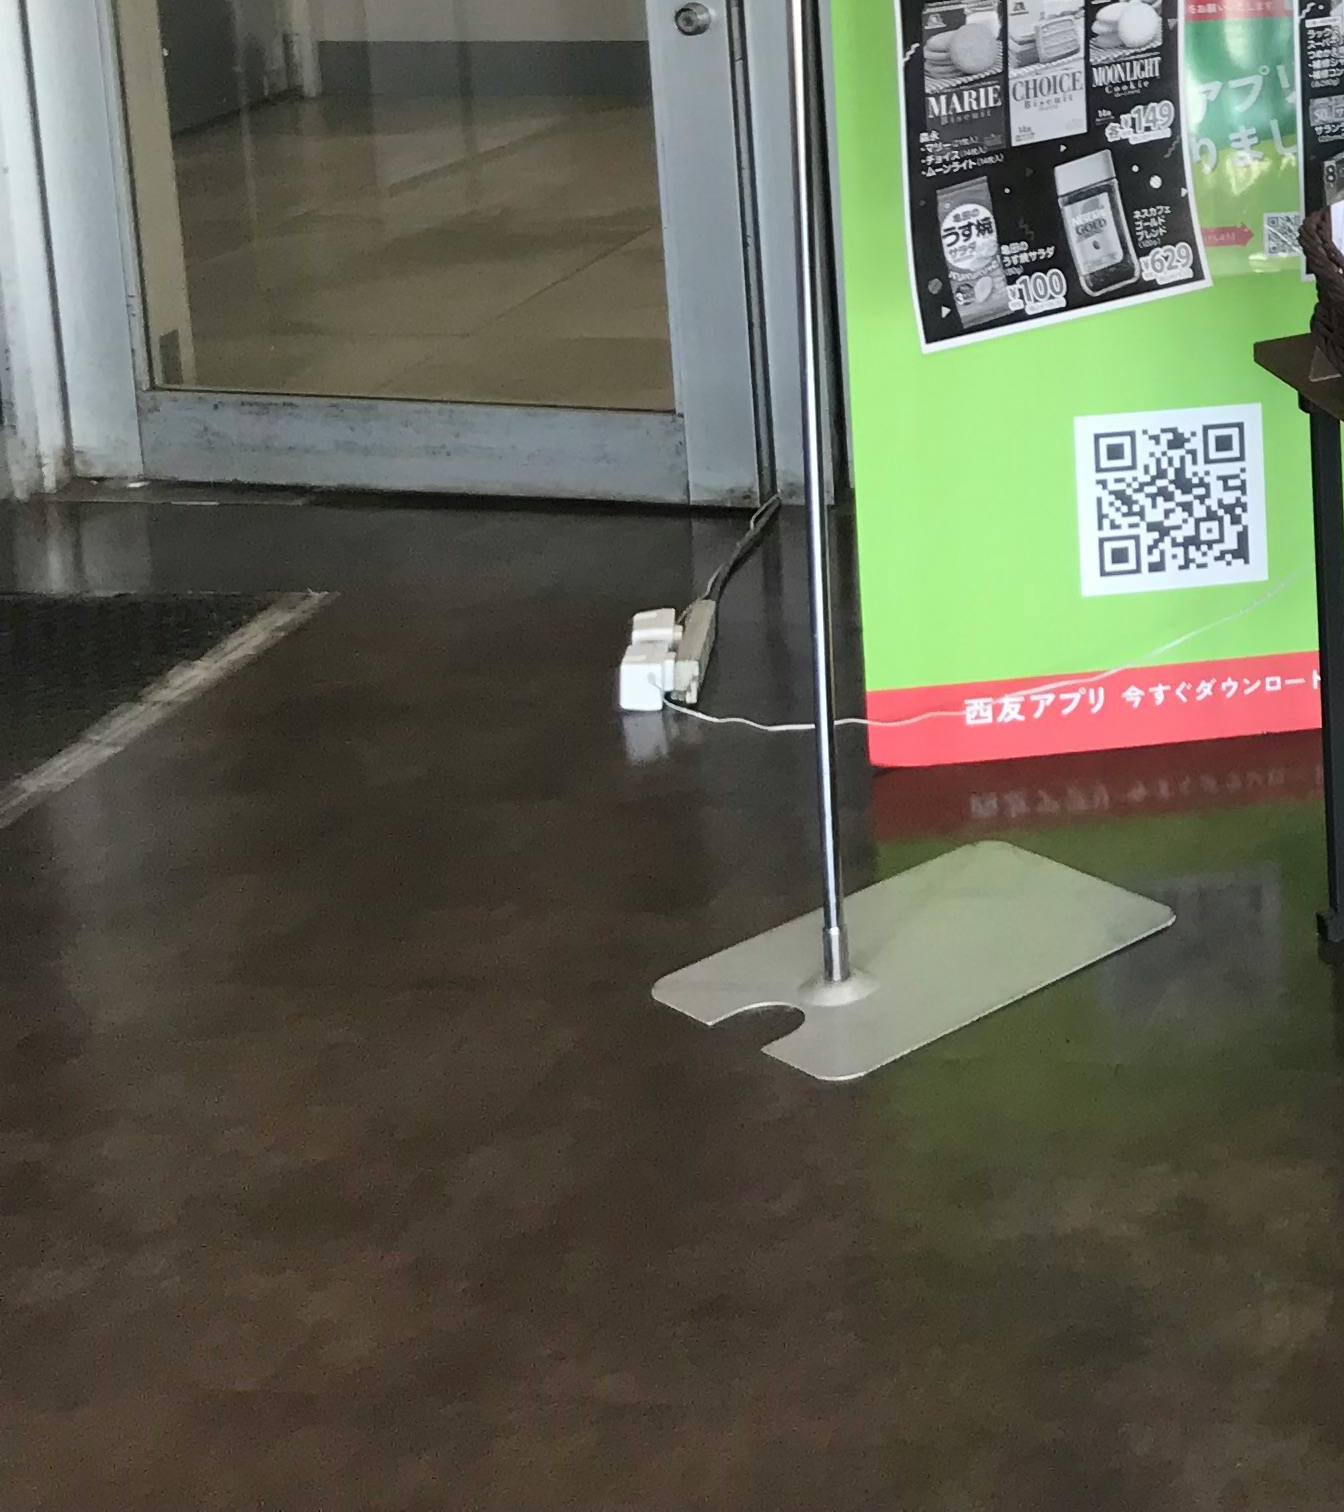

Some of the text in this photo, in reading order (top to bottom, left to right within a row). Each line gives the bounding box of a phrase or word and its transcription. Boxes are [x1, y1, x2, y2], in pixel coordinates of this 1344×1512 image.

[1012, 70, 1083, 101] CHOICE
[1092, 56, 1161, 88] MOONLIGHT
[927, 85, 1002, 119] MARIE
[1133, 206, 1171, 219] ネスカフェ
[941, 217, 993, 247] うす焼
[963, 686, 1106, 726] 西友アプリ
